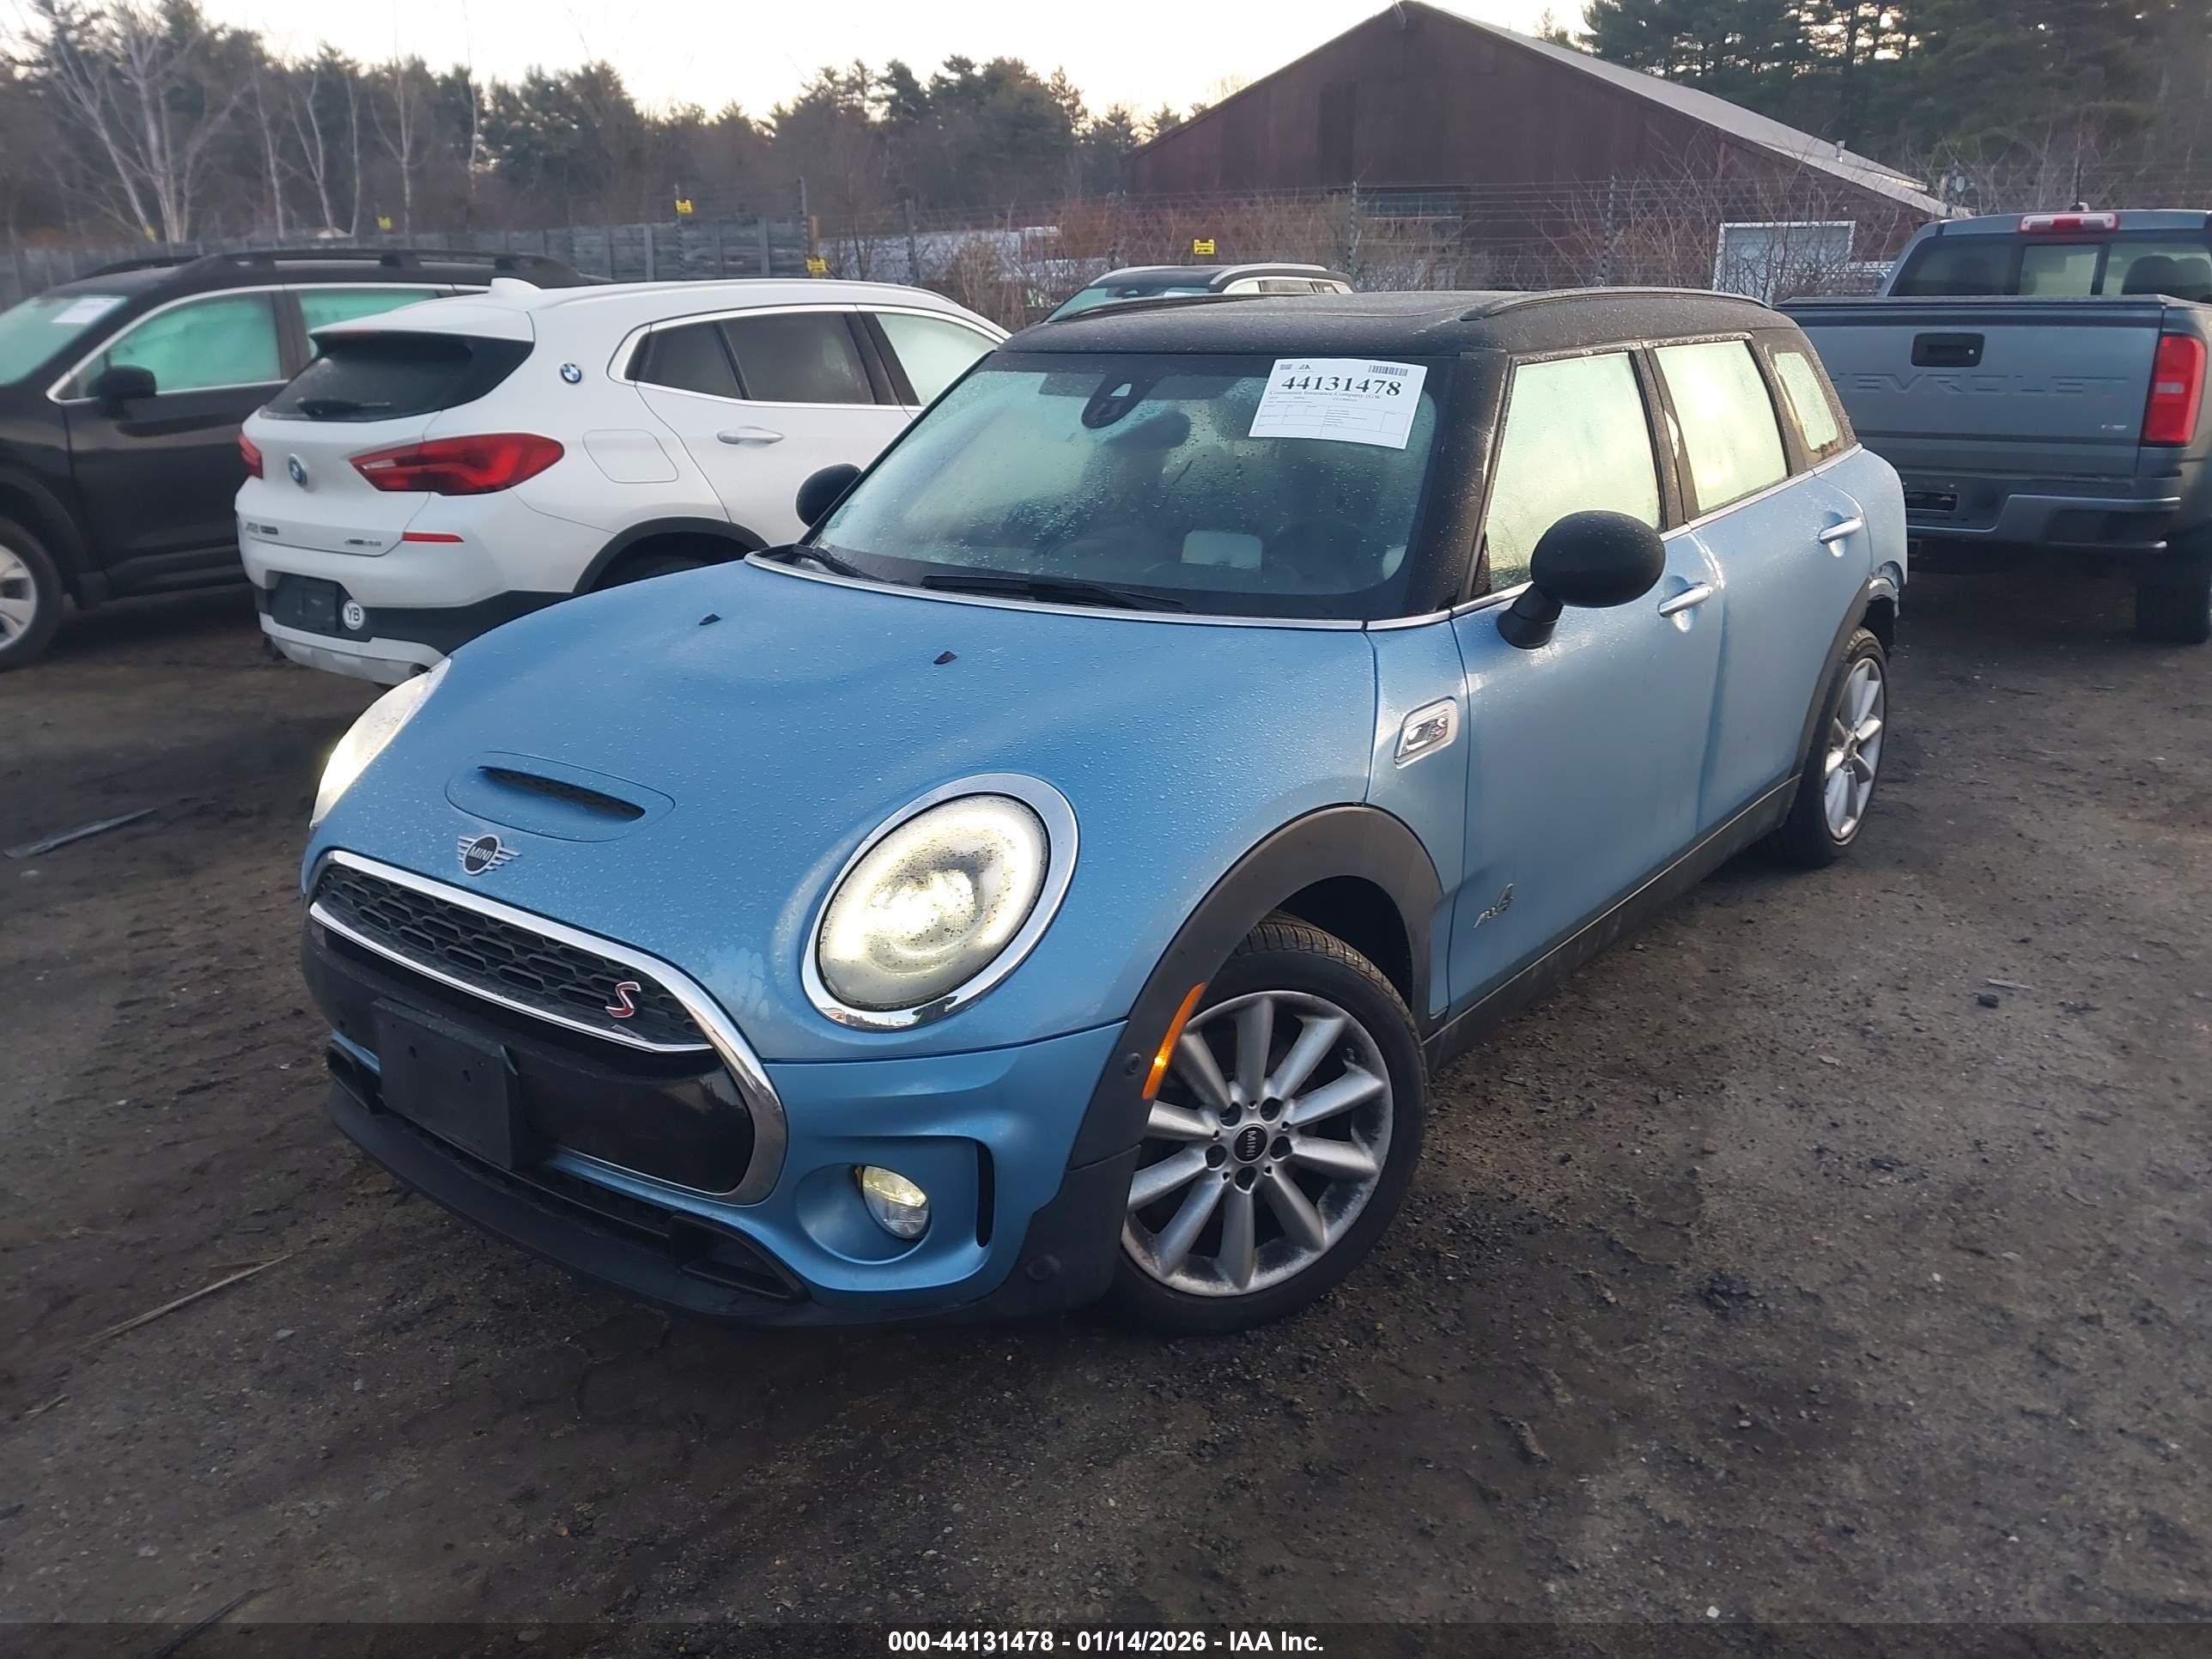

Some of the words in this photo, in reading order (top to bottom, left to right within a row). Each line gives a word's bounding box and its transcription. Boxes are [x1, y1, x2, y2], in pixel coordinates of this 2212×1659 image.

[1280, 375, 1402, 397] 44131478
[345, 606, 361, 623] YB
[467, 846, 494, 862] MINI
[605, 981, 641, 1018] S
[1245, 1129, 1258, 1157] MINI
